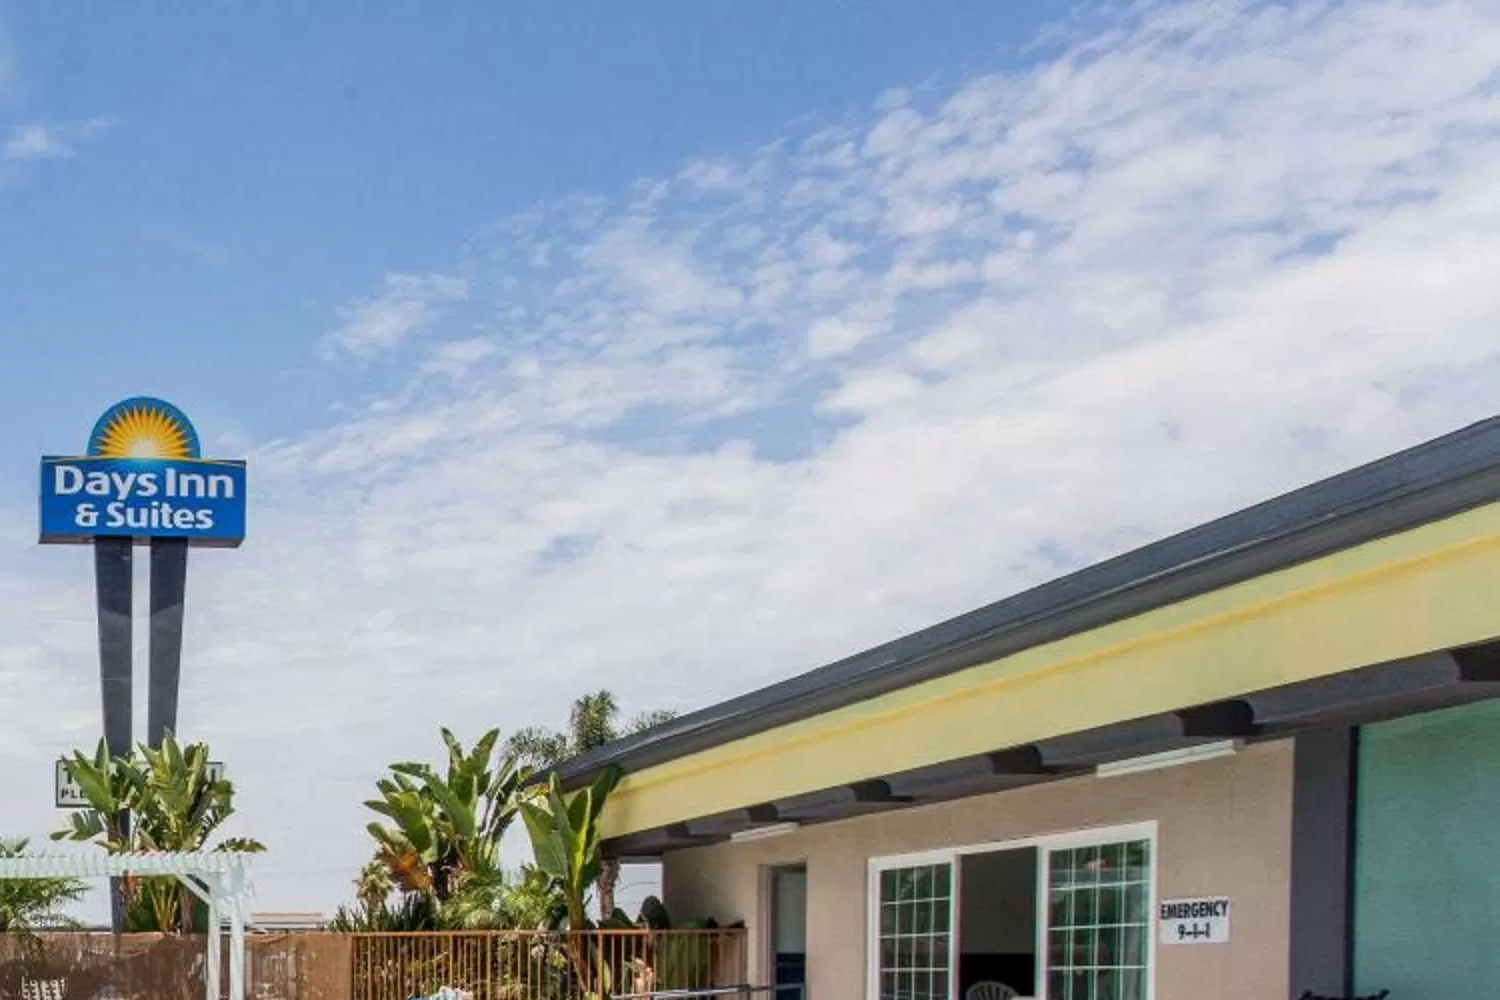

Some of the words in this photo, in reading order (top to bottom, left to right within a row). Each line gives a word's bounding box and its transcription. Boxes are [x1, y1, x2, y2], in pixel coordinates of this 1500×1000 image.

[54, 465, 158, 500] Days
[165, 468, 235, 498] Inn
[75, 504, 100, 527] &
[106, 501, 214, 529] Suites
[1161, 900, 1228, 919] EMERGENCY
